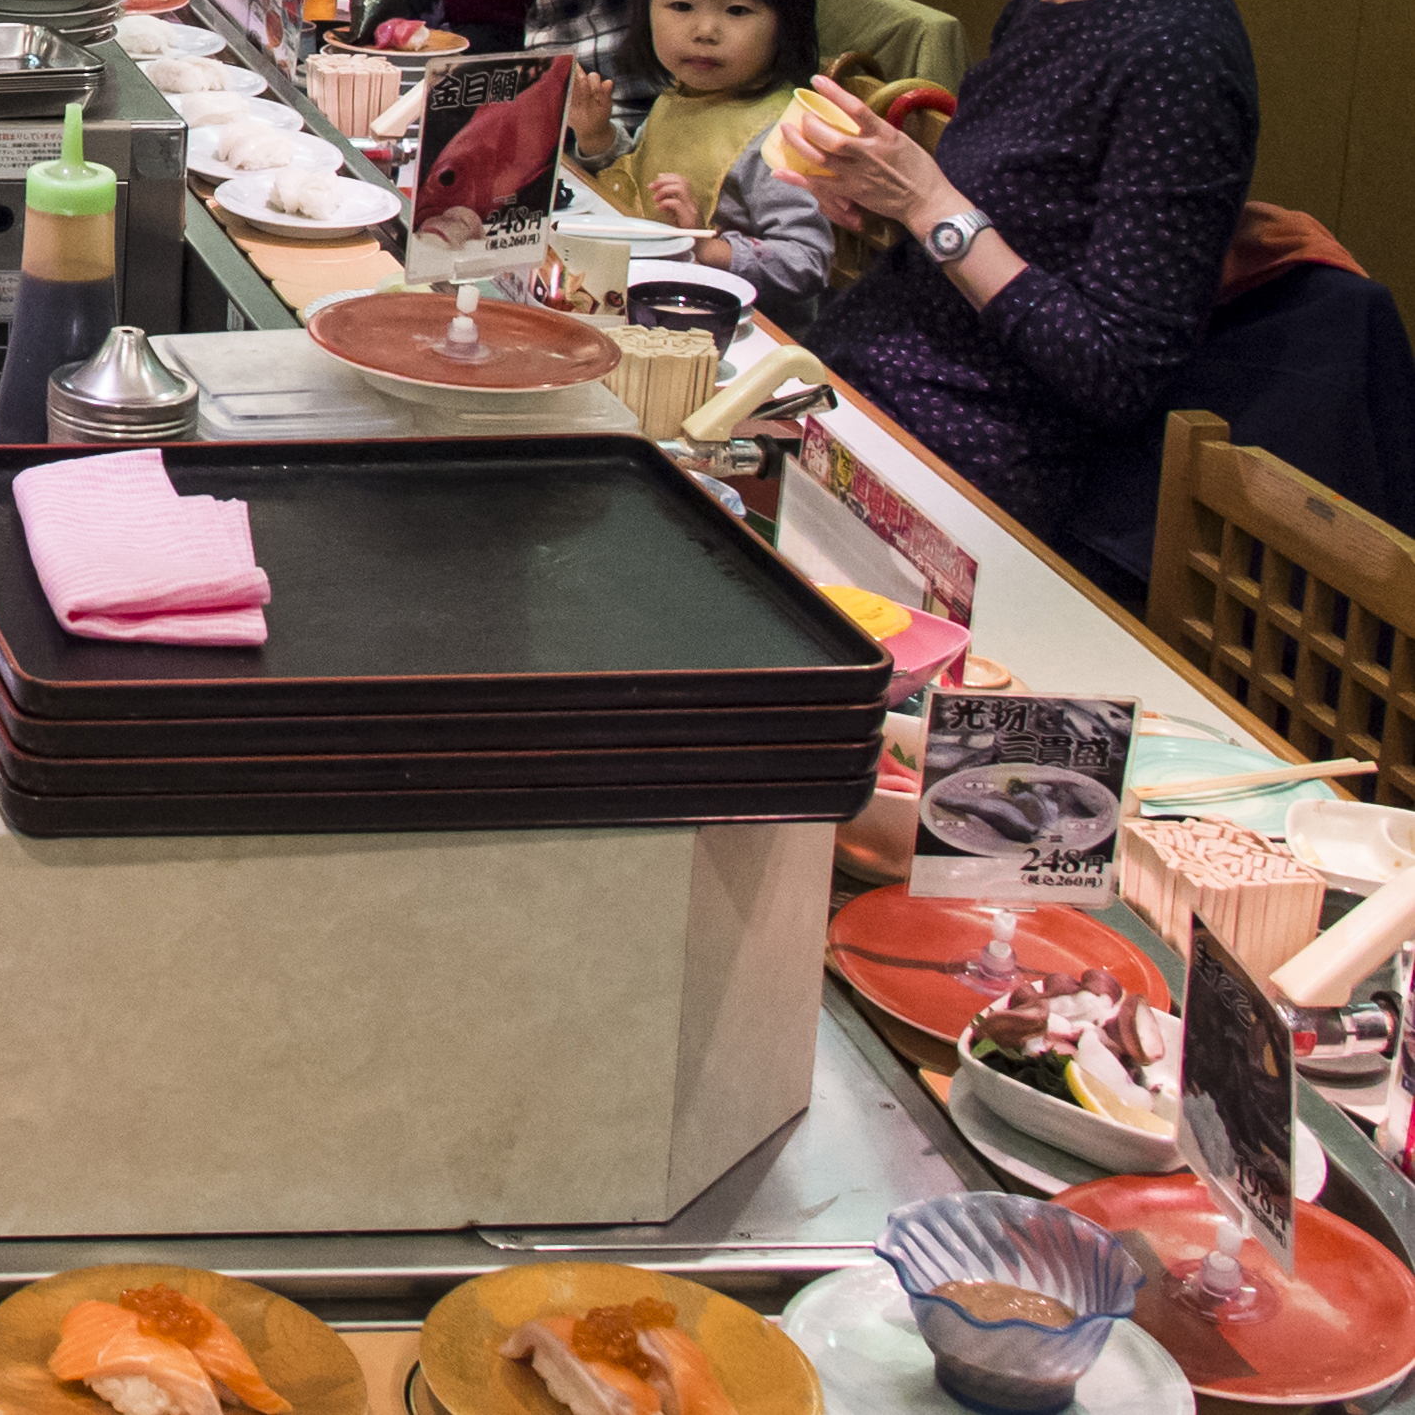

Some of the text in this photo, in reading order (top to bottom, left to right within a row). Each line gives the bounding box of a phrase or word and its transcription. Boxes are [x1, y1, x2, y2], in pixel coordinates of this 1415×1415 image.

[430, 69, 519, 111] 金目鯛
[485, 205, 544, 237] 248円
[947, 698, 1029, 733] 光物
[997, 732, 1111, 770] 三貫盛
[1020, 847, 1106, 874] 248円
[1020, 874, 1105, 888] (税込260円)
